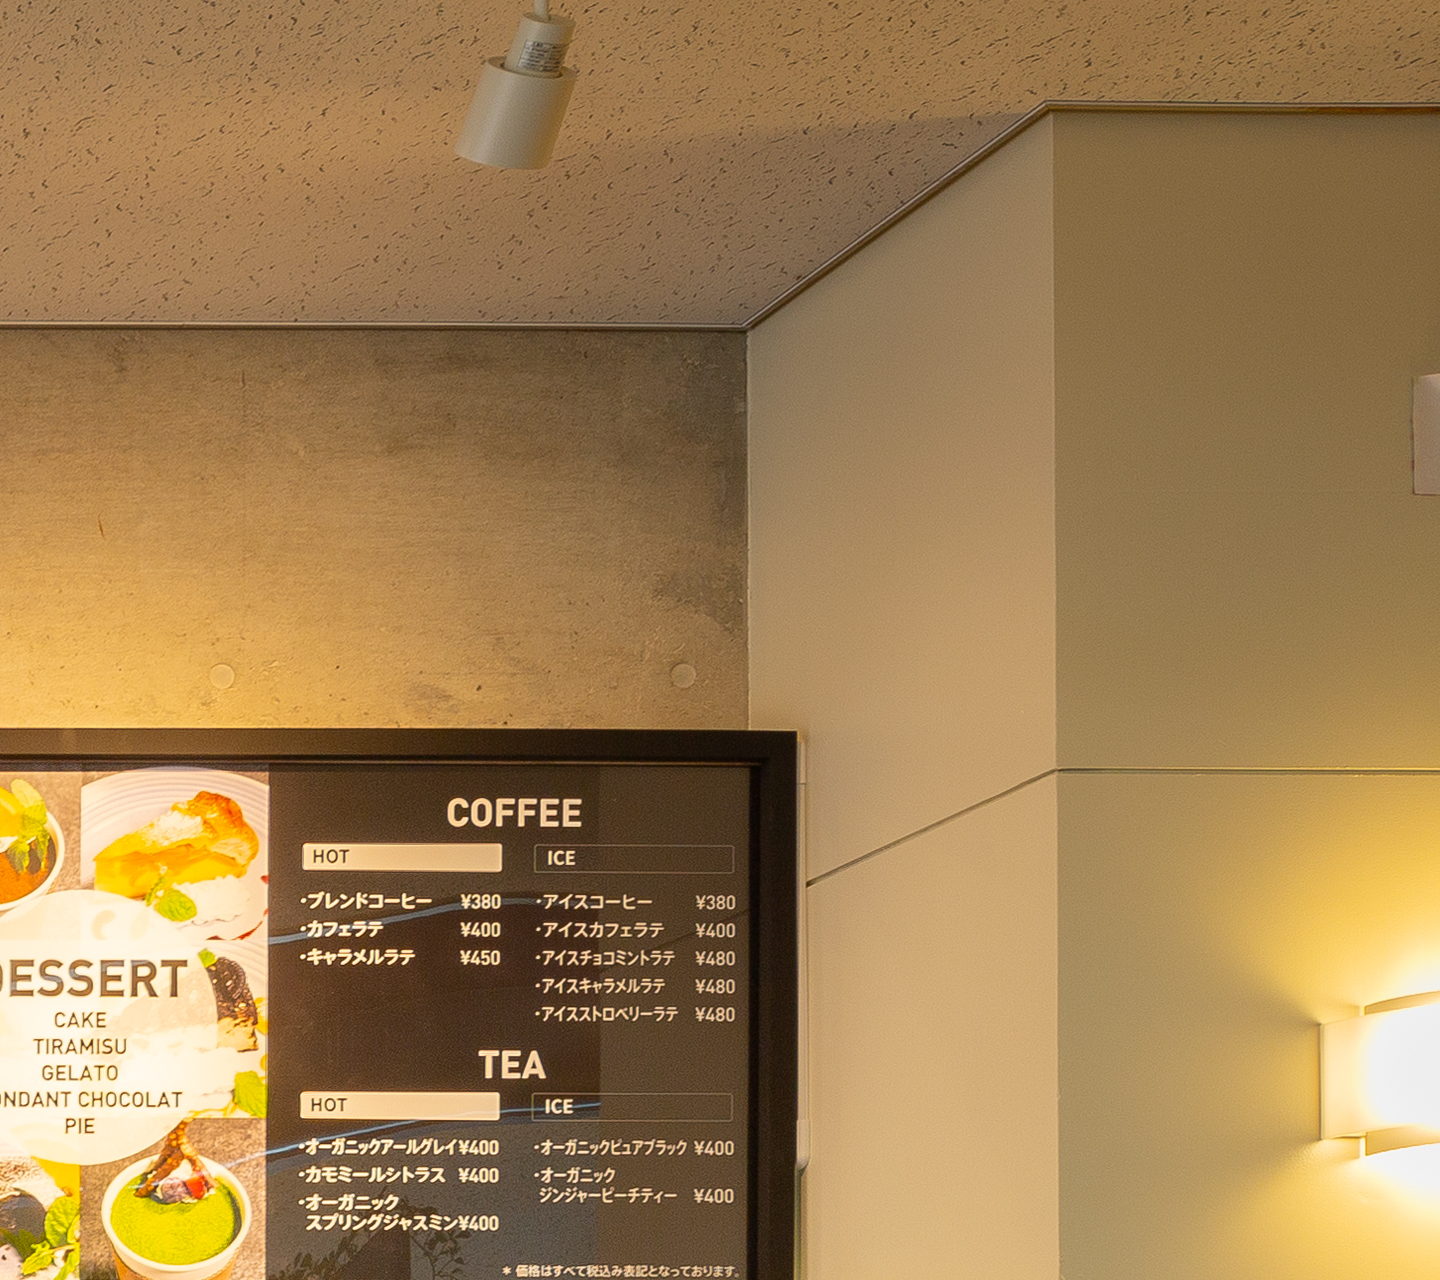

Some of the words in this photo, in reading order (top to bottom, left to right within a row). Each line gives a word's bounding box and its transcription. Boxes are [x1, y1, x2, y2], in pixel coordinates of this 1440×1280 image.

[446, 798, 582, 828] COFFEE
[313, 849, 350, 864] HOT
[547, 851, 576, 866] ICE
[461, 894, 502, 909] ¥380
[695, 894, 736, 910] ¥380
[460, 922, 502, 937] ¥400
[695, 923, 736, 938] ¥400
[460, 950, 501, 965] ¥450
[695, 951, 736, 967] ¥480
[695, 979, 736, 995] ¥480
[54, 1012, 107, 1028] CAKE
[694, 1007, 736, 1023] ¥480
[33, 1039, 127, 1055] TIRAMISU
[41, 1065, 119, 1081] GELATO
[478, 1050, 547, 1080] TEA
[78, 1091, 183, 1108] CHOCOLAT
[310, 1097, 348, 1112] HOT
[545, 1099, 574, 1114] ICE
[65, 1118, 95, 1134] PIE
[459, 1140, 499, 1155] ¥400
[694, 1140, 735, 1156] ¥400
[459, 1168, 500, 1184] ¥400
[539, 1187, 678, 1203] ジンジャーピーチティー
[694, 1188, 735, 1204] ¥400
[306, 1214, 459, 1231] スプリングジャスミン
[459, 1215, 500, 1231] ¥400
